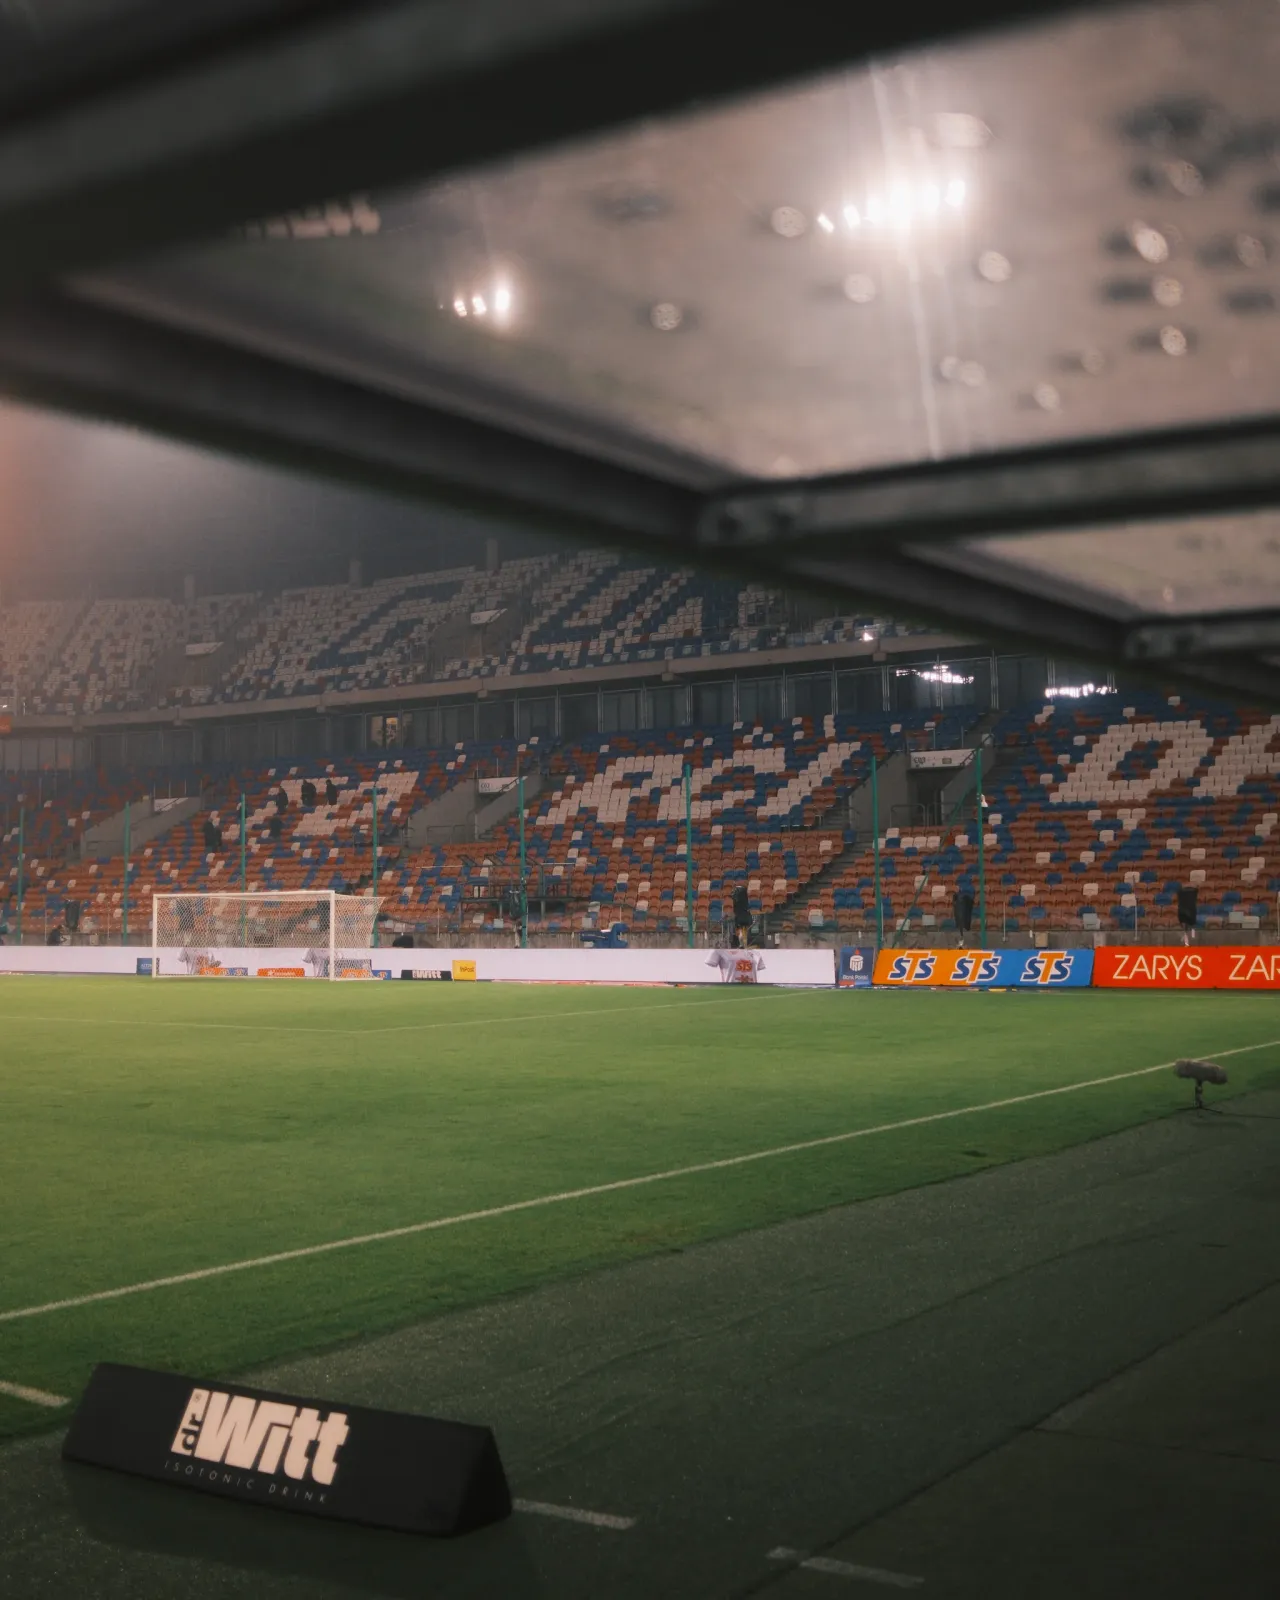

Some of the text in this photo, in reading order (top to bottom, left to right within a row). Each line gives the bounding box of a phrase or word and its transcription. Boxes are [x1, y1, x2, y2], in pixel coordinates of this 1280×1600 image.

[887, 951, 938, 983] STS
[950, 951, 1002, 984] STS
[1020, 951, 1074, 984] STS
[1113, 954, 1202, 981] ZARYS
[195, 1391, 350, 1486] Witt
[164, 1461, 327, 1504] ISOTONIC DRINK
